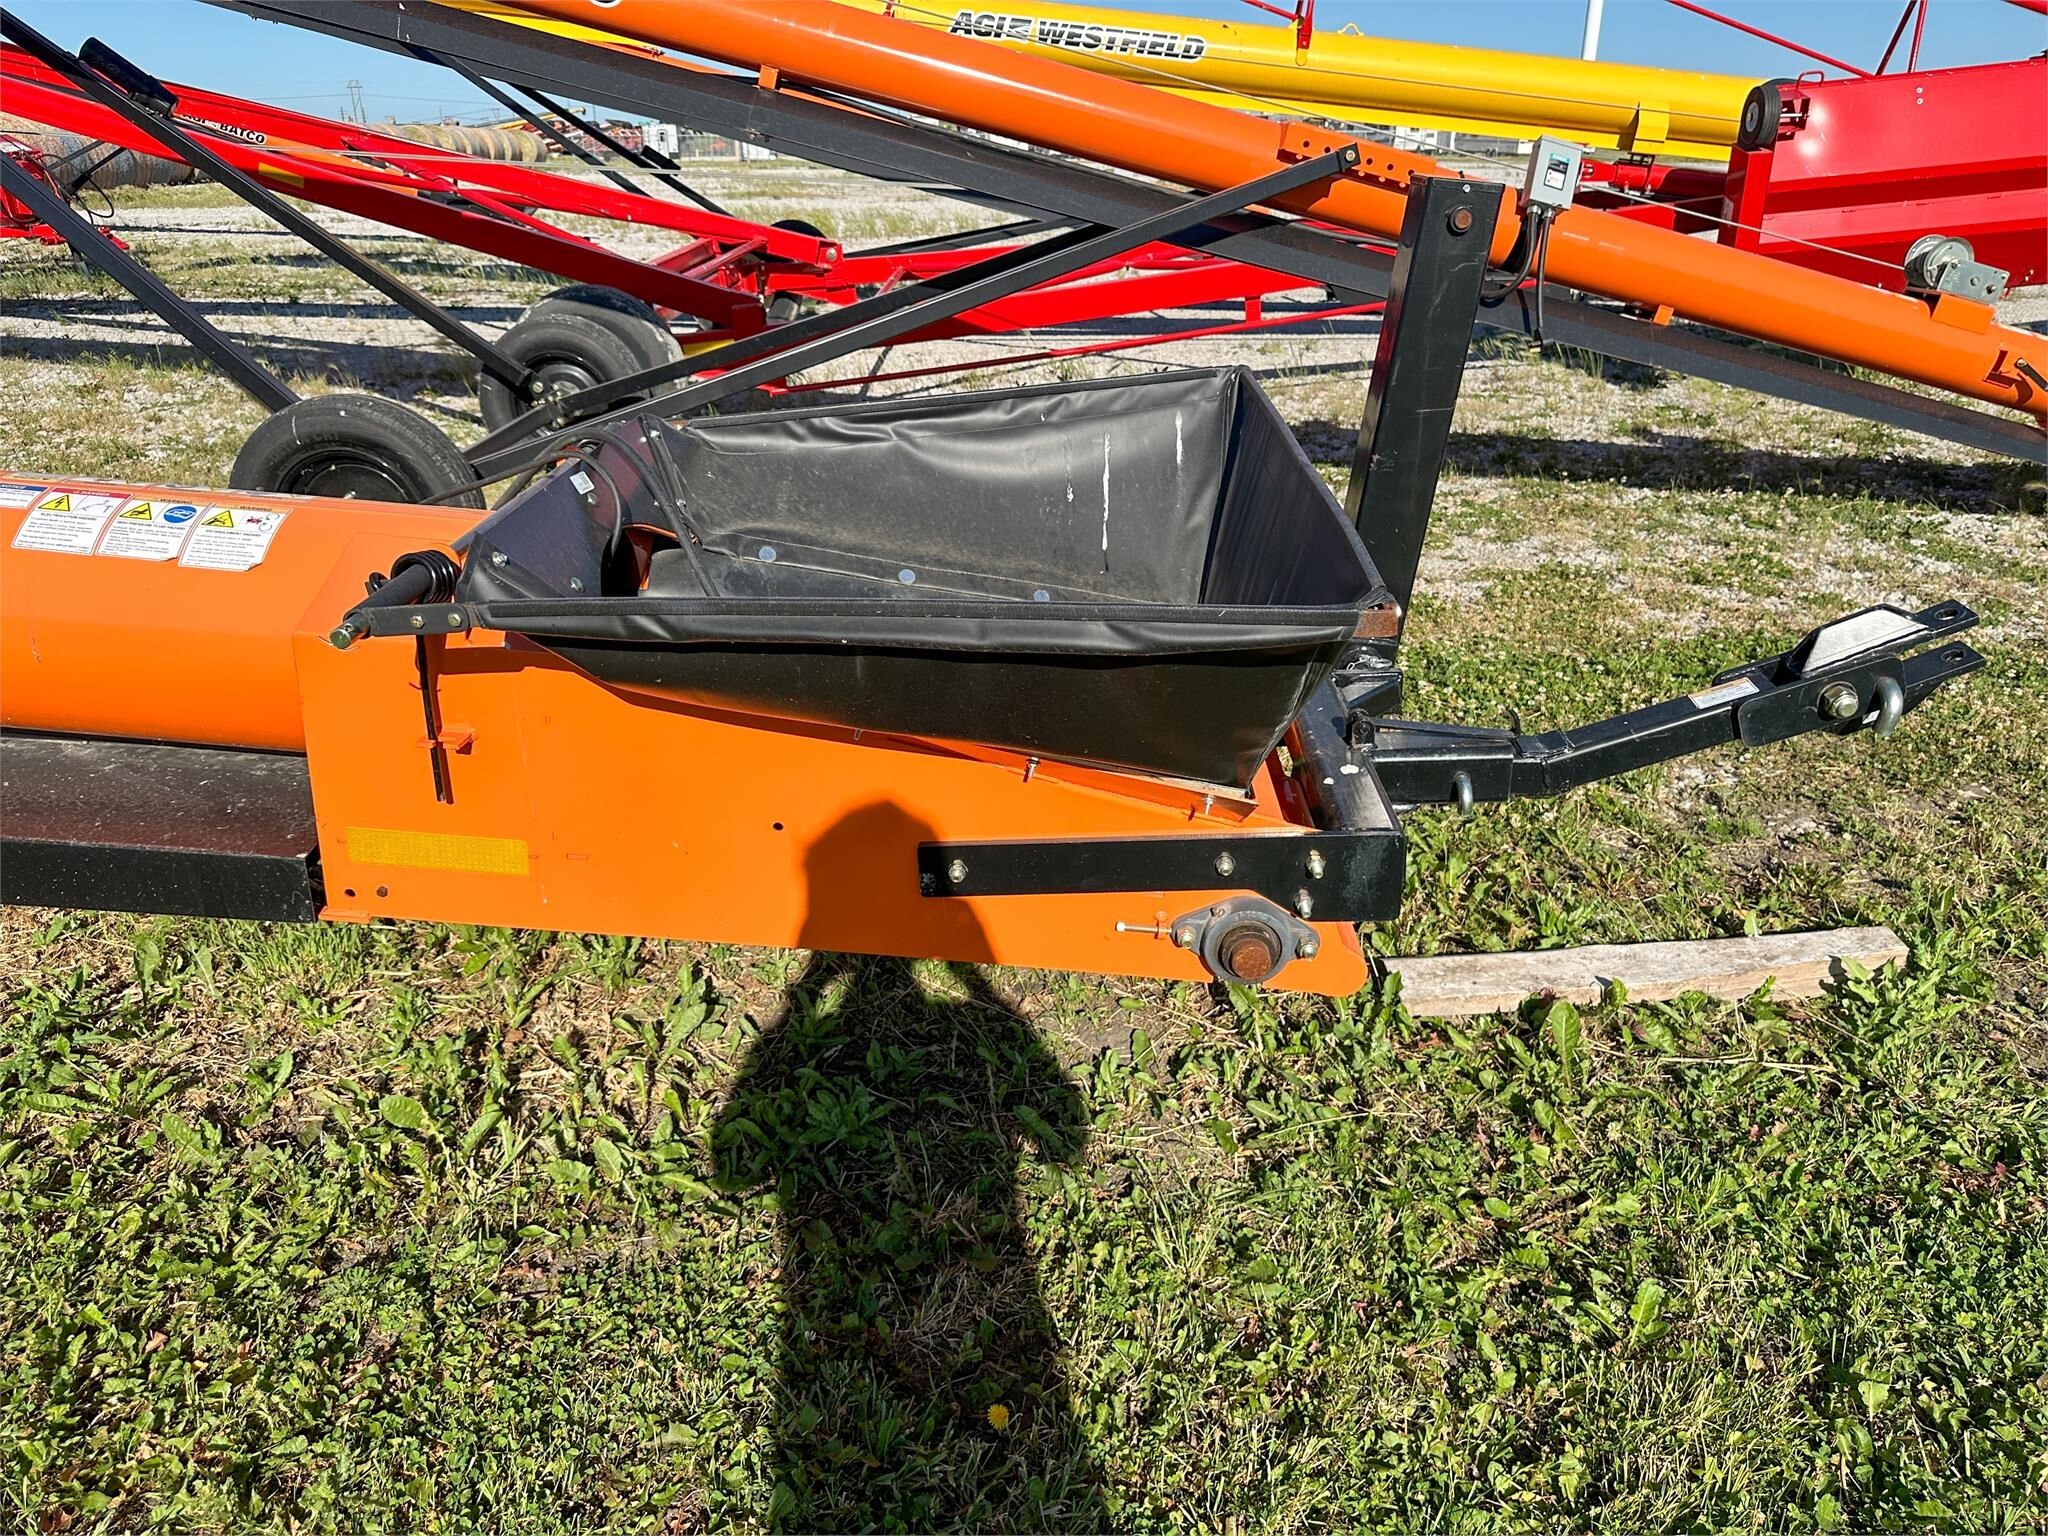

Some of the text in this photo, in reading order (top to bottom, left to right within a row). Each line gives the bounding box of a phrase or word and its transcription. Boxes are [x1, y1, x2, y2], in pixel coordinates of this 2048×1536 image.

[950, 12, 1206, 60] AGI WESTFIELD
[219, 123, 265, 144] BATCO
